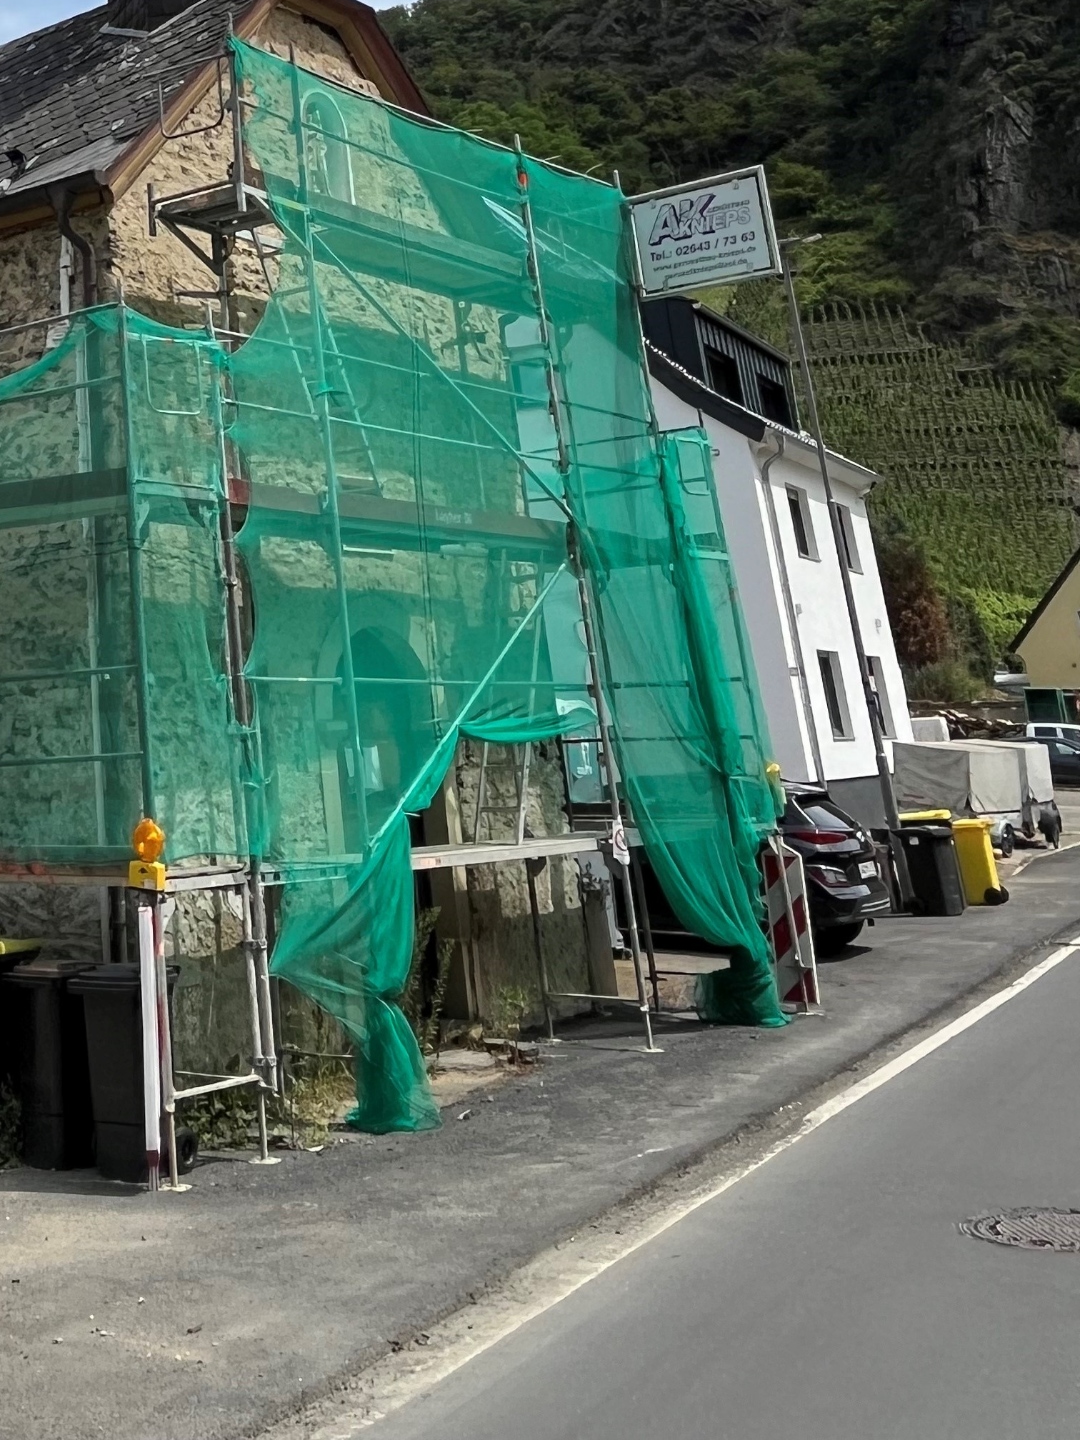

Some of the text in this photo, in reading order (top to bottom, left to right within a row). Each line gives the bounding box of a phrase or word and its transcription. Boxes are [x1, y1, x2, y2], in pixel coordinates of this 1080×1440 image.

[672, 207, 750, 240] KNIEPS
[676, 241, 710, 256] 02643
[723, 235, 737, 247] 73
